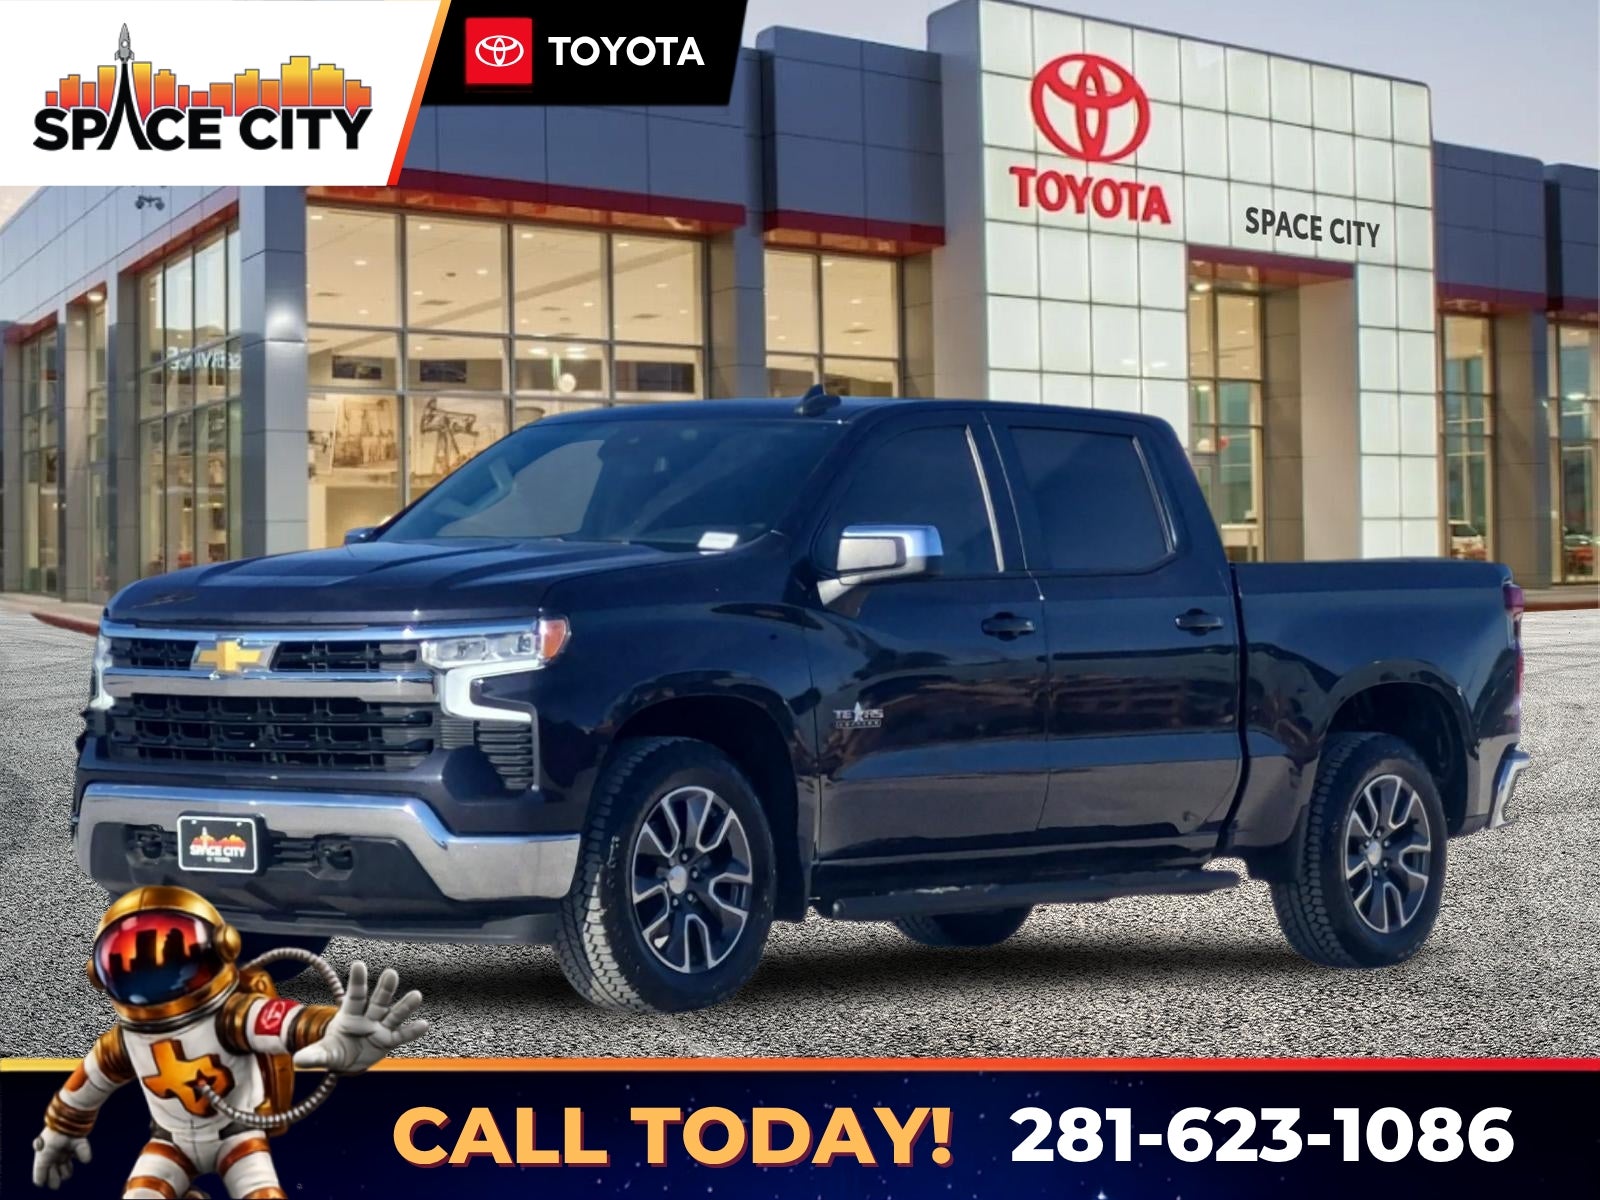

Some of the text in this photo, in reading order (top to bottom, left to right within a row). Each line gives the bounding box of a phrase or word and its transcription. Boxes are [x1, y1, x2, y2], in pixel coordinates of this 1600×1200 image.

[1009, 167, 1171, 224] TOYOTA
[1245, 207, 1381, 248] SPACE CITY
[223, 845, 246, 857] CITY
